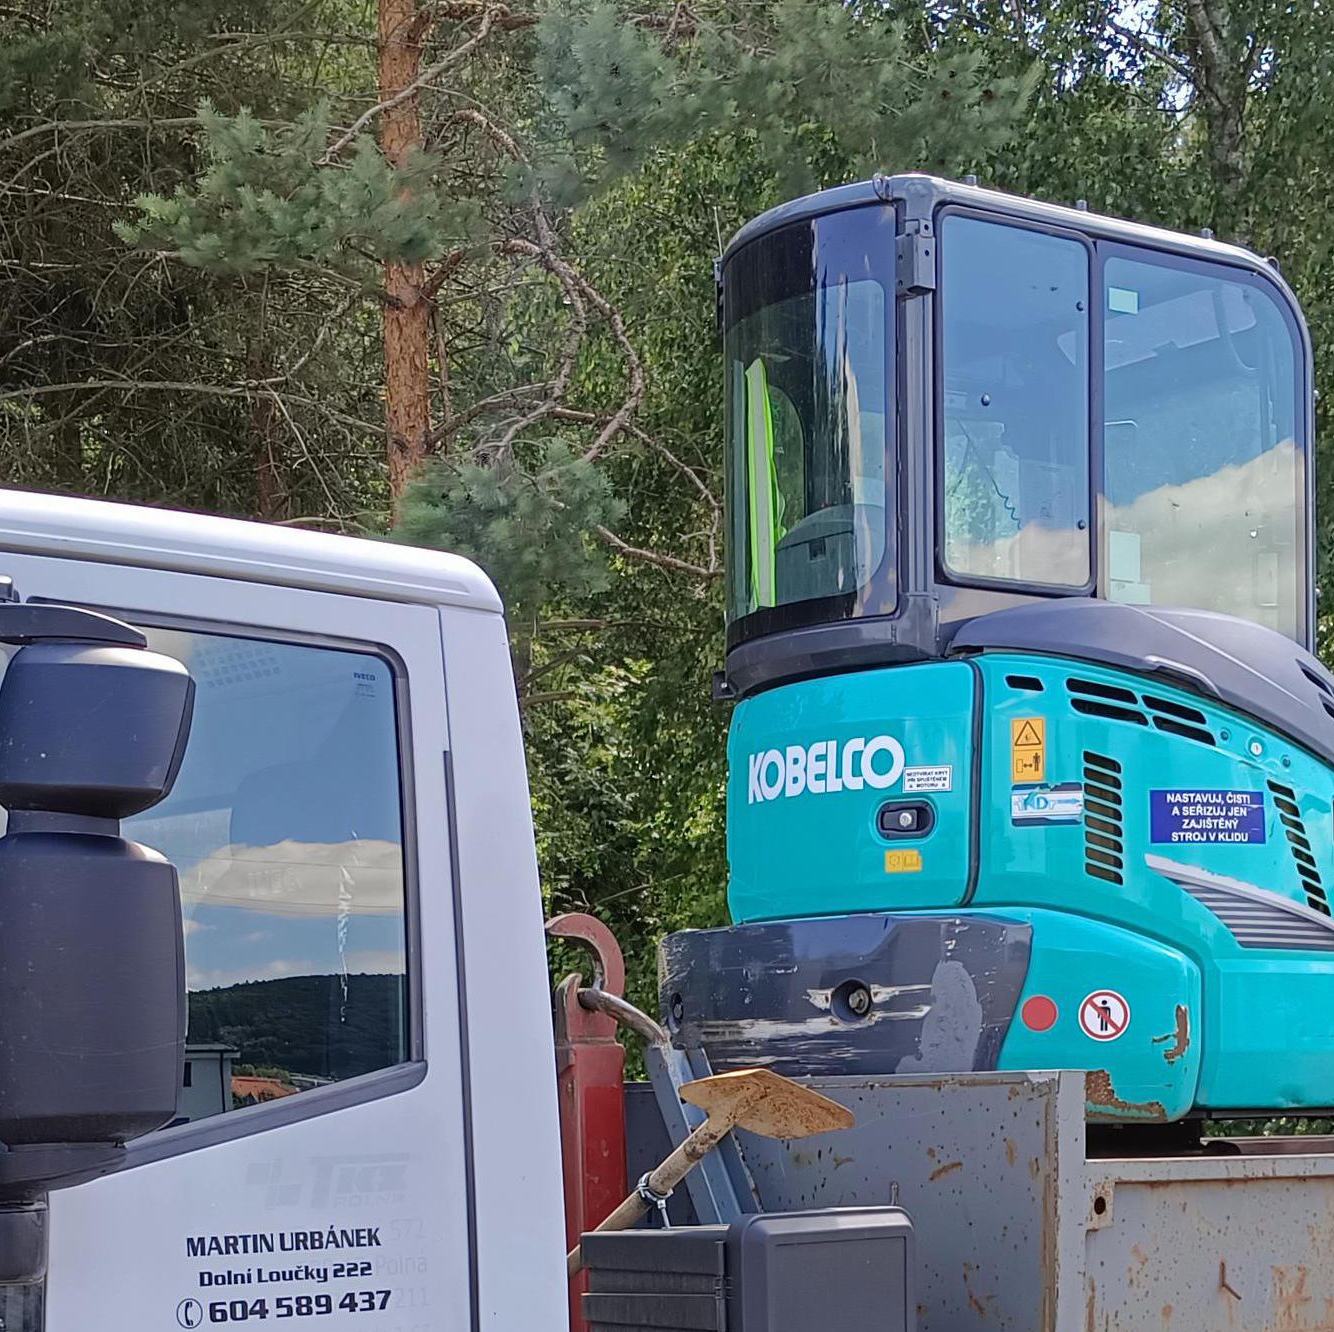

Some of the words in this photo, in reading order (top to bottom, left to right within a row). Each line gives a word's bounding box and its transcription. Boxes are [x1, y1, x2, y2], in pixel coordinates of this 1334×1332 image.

[748, 735, 905, 804] KOBELCO
[1166, 793, 1224, 804] NASTAVUJ,
[1172, 806, 1180, 816] A
[1182, 804, 1226, 816] SEŘIZUJ
[1227, 807, 1247, 817] JEN
[1182, 817, 1238, 829] ZAJIŠTĚNÝ
[1171, 832, 1206, 842] STROJ
[1208, 832, 1218, 841] V
[1218, 832, 1248, 842] KLIDU
[186, 1233, 274, 1257] MARTIN
[279, 1225, 381, 1251] URBÁNEK
[199, 1268, 252, 1287] Dolní
[257, 1265, 328, 1283] Loučky
[333, 1261, 372, 1278] 222
[209, 1299, 269, 1323] 604
[276, 1294, 332, 1318] 589
[339, 1290, 392, 1313] 437
